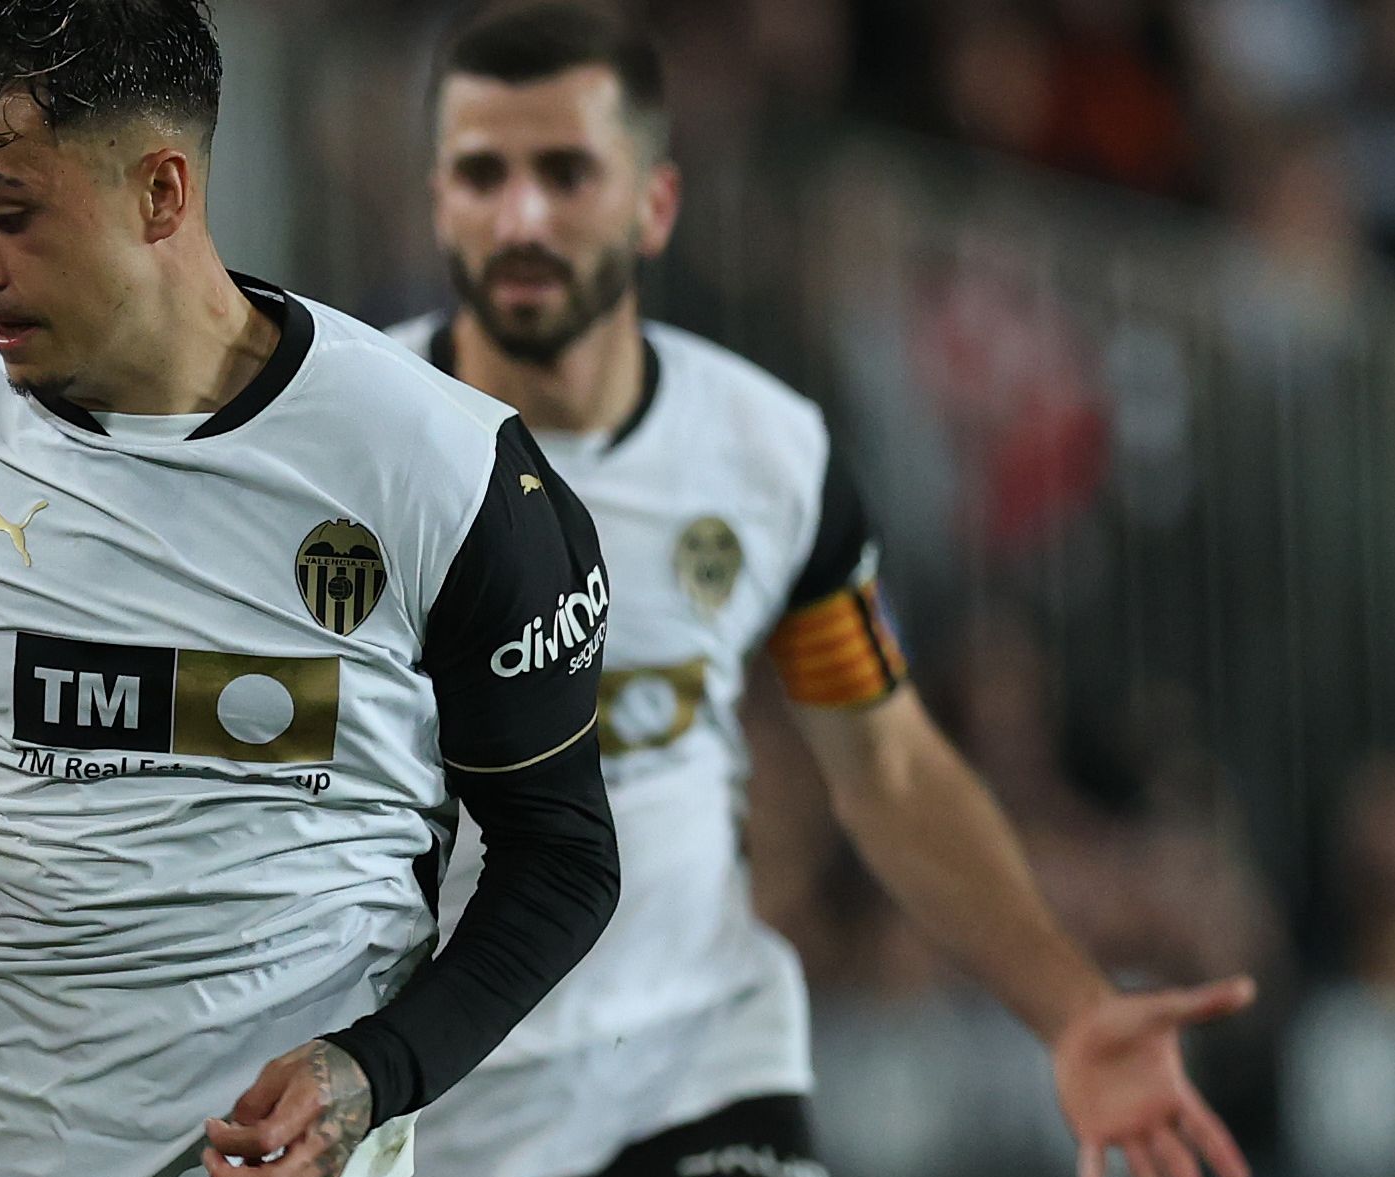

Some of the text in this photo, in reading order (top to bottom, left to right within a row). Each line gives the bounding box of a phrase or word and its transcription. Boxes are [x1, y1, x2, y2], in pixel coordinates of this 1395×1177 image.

[305, 556, 358, 567] VALENCIA
[490, 564, 609, 678] divina
[568, 619, 607, 675] seguro
[33, 665, 141, 730] TM
[64, 756, 128, 779] Real
